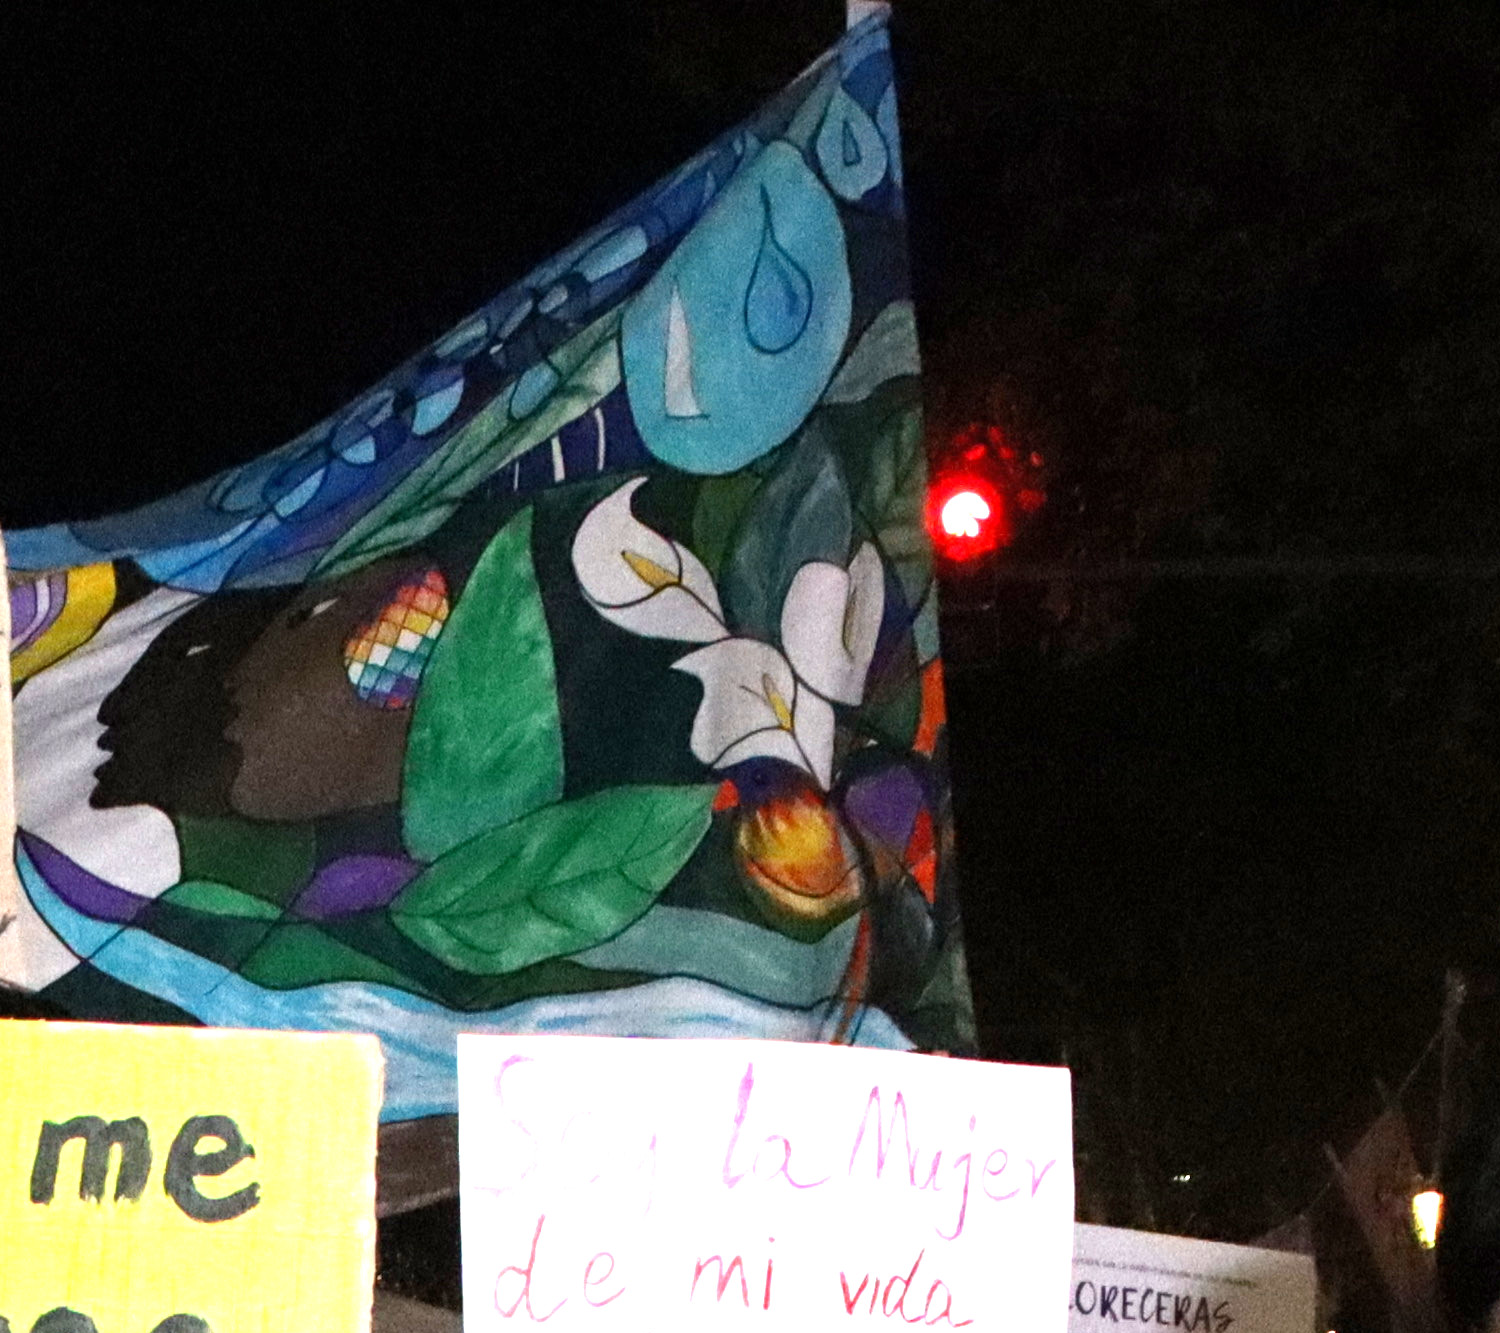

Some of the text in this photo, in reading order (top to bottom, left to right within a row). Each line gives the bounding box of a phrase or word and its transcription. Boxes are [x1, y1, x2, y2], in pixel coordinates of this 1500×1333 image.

[30, 1114, 261, 1223] me
[848, 1085, 1056, 1241] Mujer
[494, 1214, 975, 1327] de mi vida
